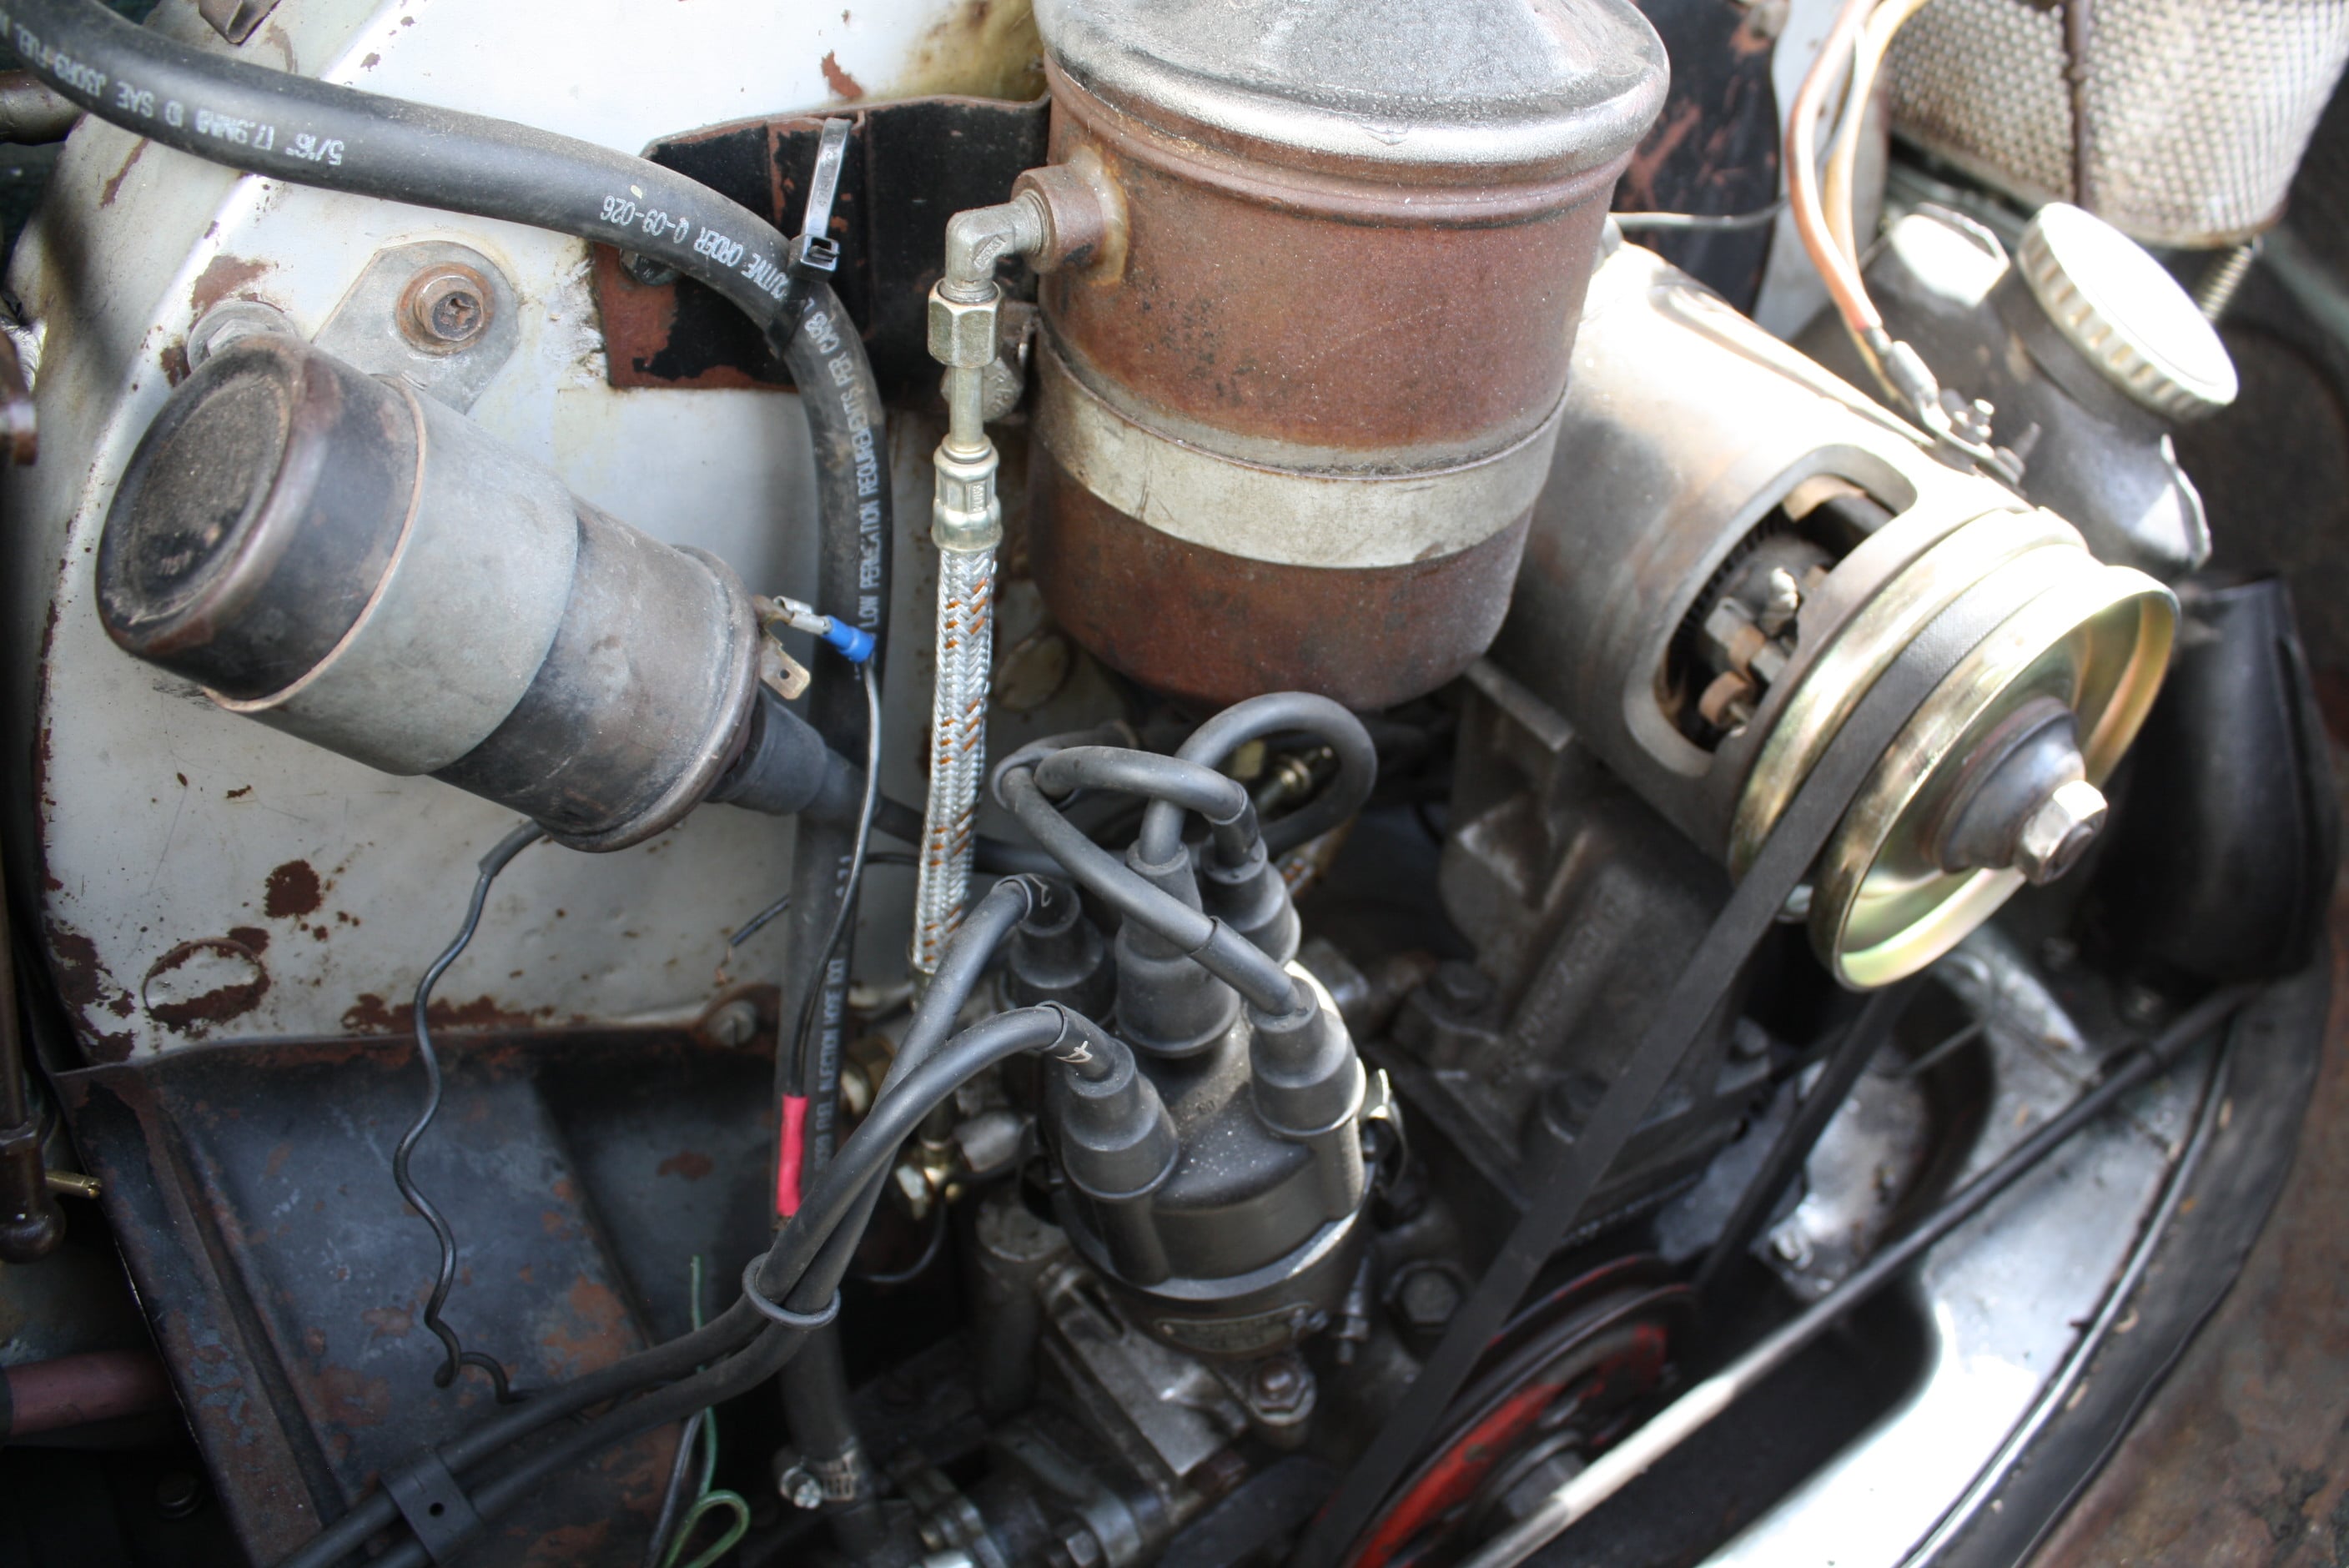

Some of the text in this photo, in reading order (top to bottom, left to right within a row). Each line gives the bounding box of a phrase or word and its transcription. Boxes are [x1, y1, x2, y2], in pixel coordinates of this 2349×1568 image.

[116, 81, 154, 118] SAE
[600, 195, 690, 244] Q-09-026
[693, 226, 743, 268] ORDER
[804, 310, 840, 354] CARB
[828, 350, 855, 387] PER
[858, 595, 879, 628] LOW
